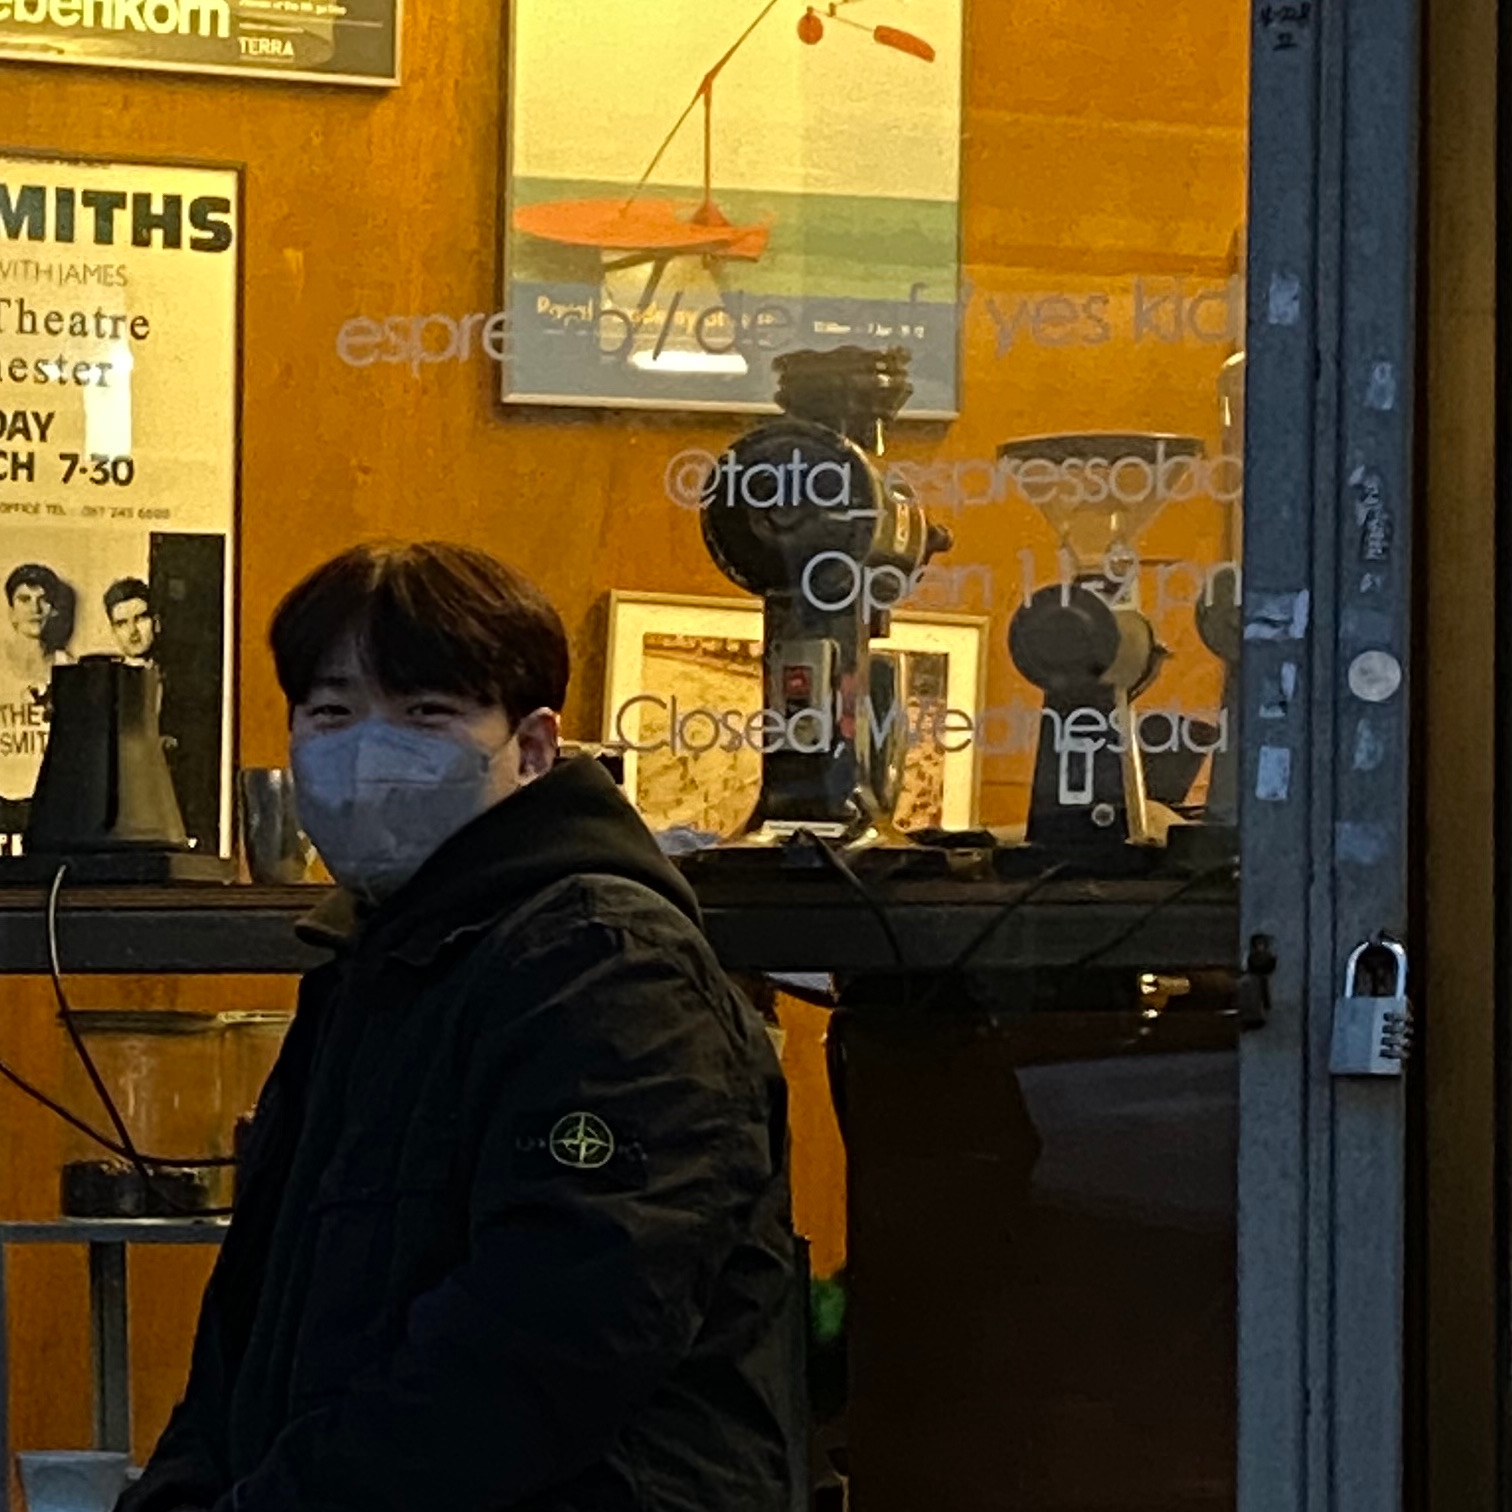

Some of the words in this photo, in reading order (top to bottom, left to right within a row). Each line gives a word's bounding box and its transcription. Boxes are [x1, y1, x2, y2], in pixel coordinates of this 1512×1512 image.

[239, 37, 294, 56] TERRA
[58, 263, 129, 287] JAMES
[801, 550, 988, 624] Open
